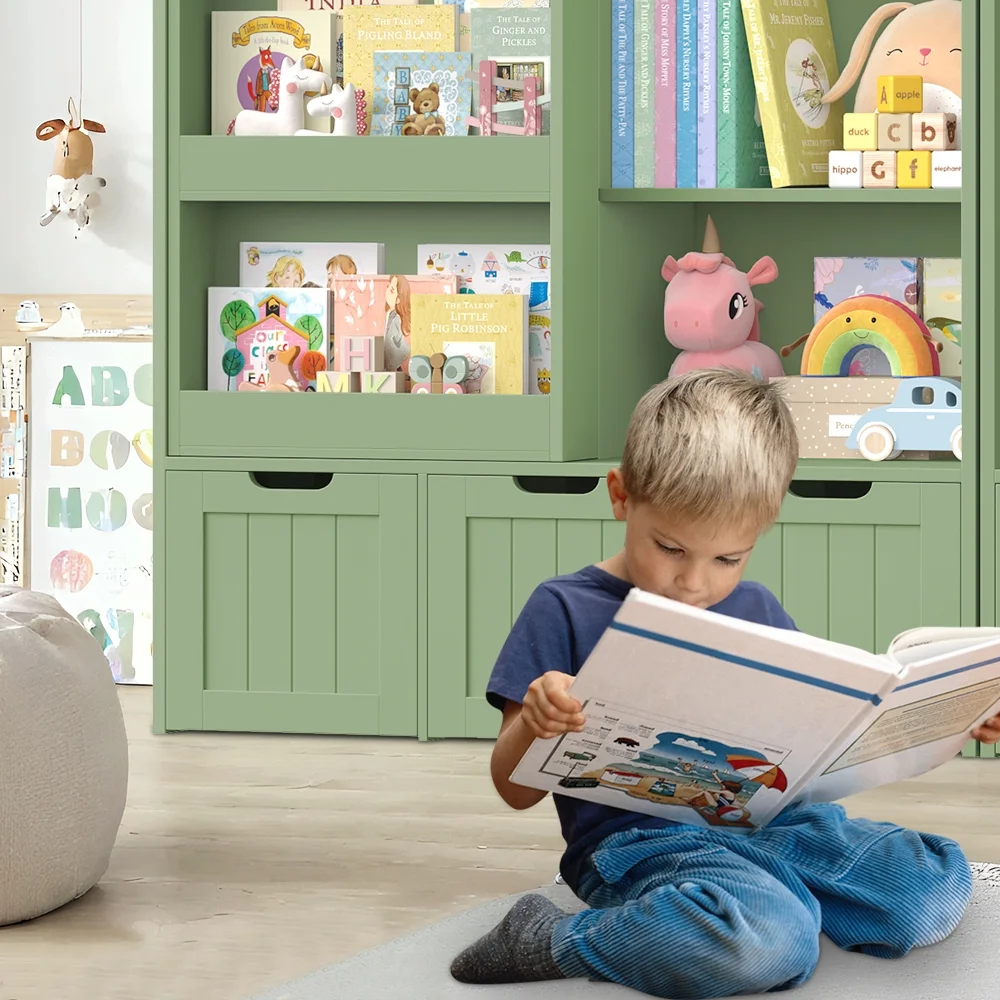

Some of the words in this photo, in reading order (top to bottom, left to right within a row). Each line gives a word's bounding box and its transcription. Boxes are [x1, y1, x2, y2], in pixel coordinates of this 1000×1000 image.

[618, 4, 628, 22] TALE
[641, 3, 650, 22] TALE
[661, 4, 670, 26] STORY
[722, 1, 732, 19] TALE
[373, 18, 391, 26] THE
[392, 18, 413, 26] TALE
[492, 25, 526, 35] GINGER
[527, 26, 546, 35] AND
[618, 23, 627, 33] OF
[641, 23, 649, 32] OF
[722, 20, 730, 30] OF
[357, 29, 402, 40] PIGLING
[405, 29, 442, 40] BLAND
[661, 27, 669, 37] OF
[502, 37, 537, 47] PICKLES
[618, 34, 628, 49] THE
[641, 33, 650, 61] GINGER
[661, 38, 670, 57] MISS
[721, 31, 731, 60] JOHNNY
[618, 51, 628, 62] PIE
[683, 47, 692, 80] NURSERY
[618, 63, 627, 78] AND
[641, 62, 649, 78] AND
[661, 58, 670, 87] MOPPET
[703, 51, 712, 82] NURSERY
[618, 80, 628, 95] THE
[722, 61, 732, 114] TOWN-MOUSE
[880, 86, 888, 104] A
[896, 90, 920, 99] apple
[618, 96, 628, 136] PATTY-PAN
[848, 128, 869, 136] duck
[887, 123, 901, 142] C
[921, 121, 936, 141] b
[832, 165, 858, 174] hippo
[871, 160, 885, 179] G
[909, 158, 918, 179] f
[444, 301, 460, 309] THE
[463, 301, 483, 309] TALE
[451, 311, 488, 321] LITTLE
[430, 323, 450, 333] PIG
[453, 323, 508, 333] ROBINSON
[256, 331, 284, 342] our
[345, 339, 370, 370] H
[366, 374, 391, 392] K
